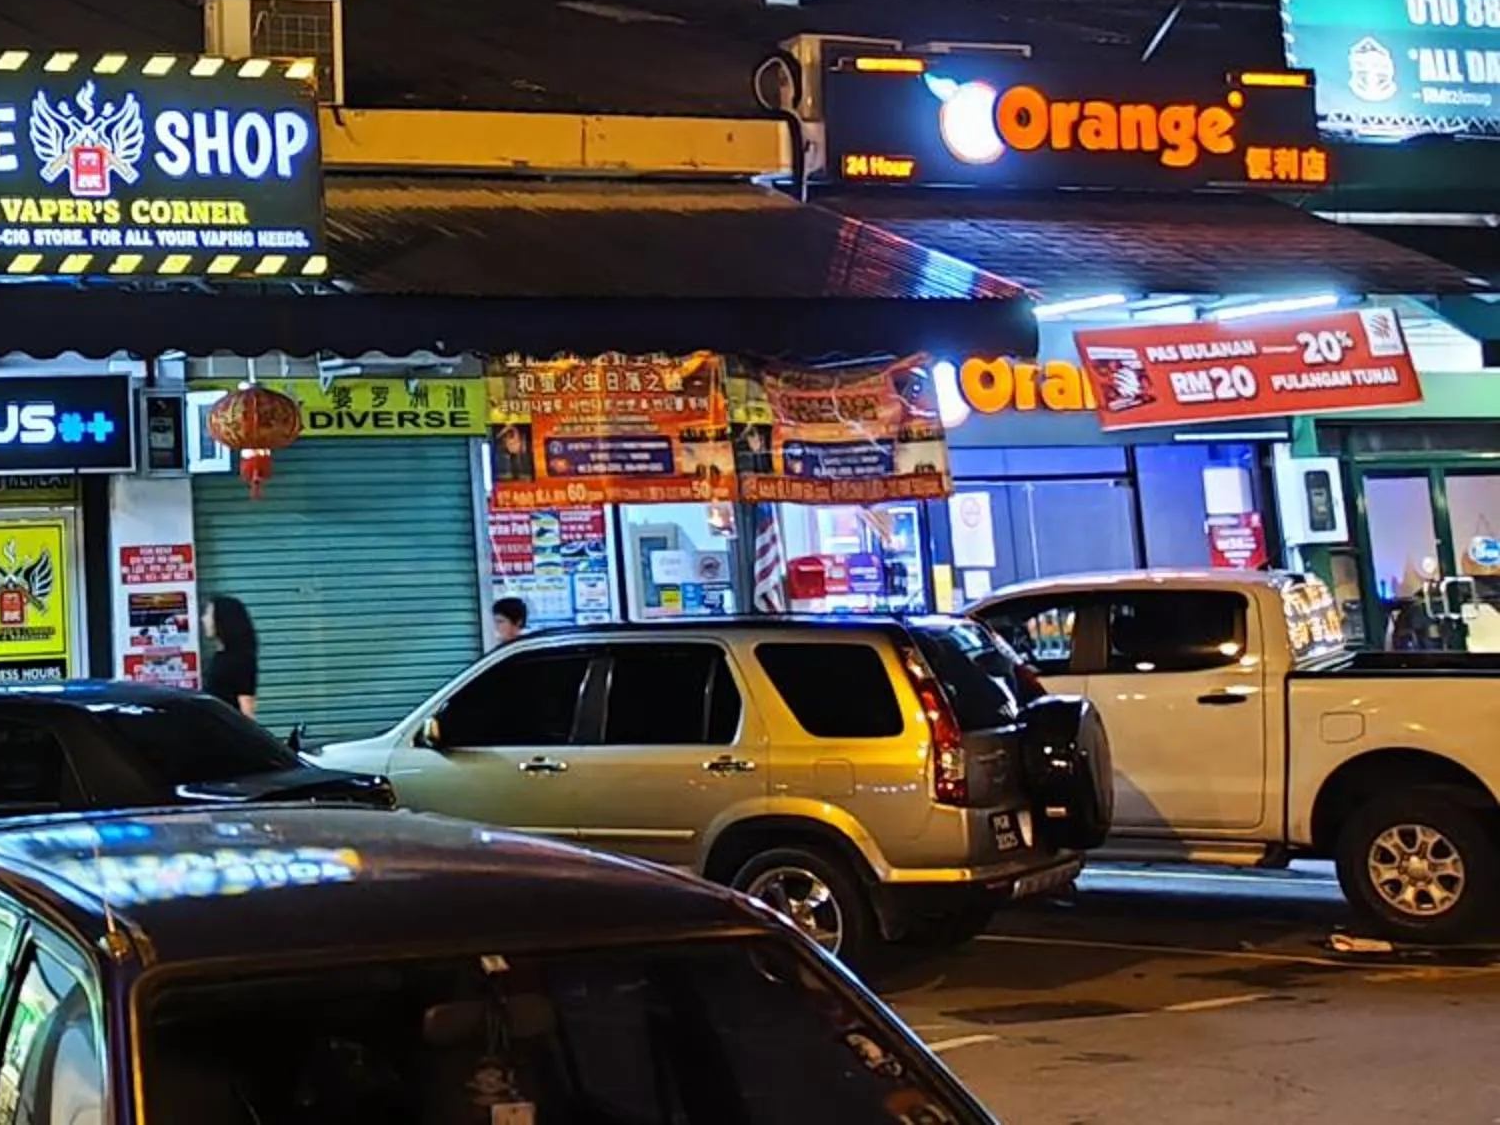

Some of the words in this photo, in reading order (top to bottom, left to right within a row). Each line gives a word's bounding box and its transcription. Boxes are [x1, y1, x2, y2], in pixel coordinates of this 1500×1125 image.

[995, 84, 1236, 167] Orange
[154, 109, 310, 178] SHOP
[846, 155, 868, 176] 24
[1245, 146, 1328, 182] 便利店
[0, 198, 121, 224] VAPER'S
[131, 199, 249, 225] CORNER
[91, 229, 122, 246] FOR
[124, 229, 154, 246] ALL
[155, 230, 199, 246] YOUR
[200, 230, 255, 247] VAPING
[1146, 344, 1178, 363] PAS
[1178, 340, 1257, 361] BULANAN
[1170, 365, 1258, 404] RM20
[1270, 370, 1353, 393] PULANGAN
[1353, 367, 1399, 387] TUNAI
[310, 410, 472, 429] DIVERSE
[21, 666, 62, 681] HOURS
